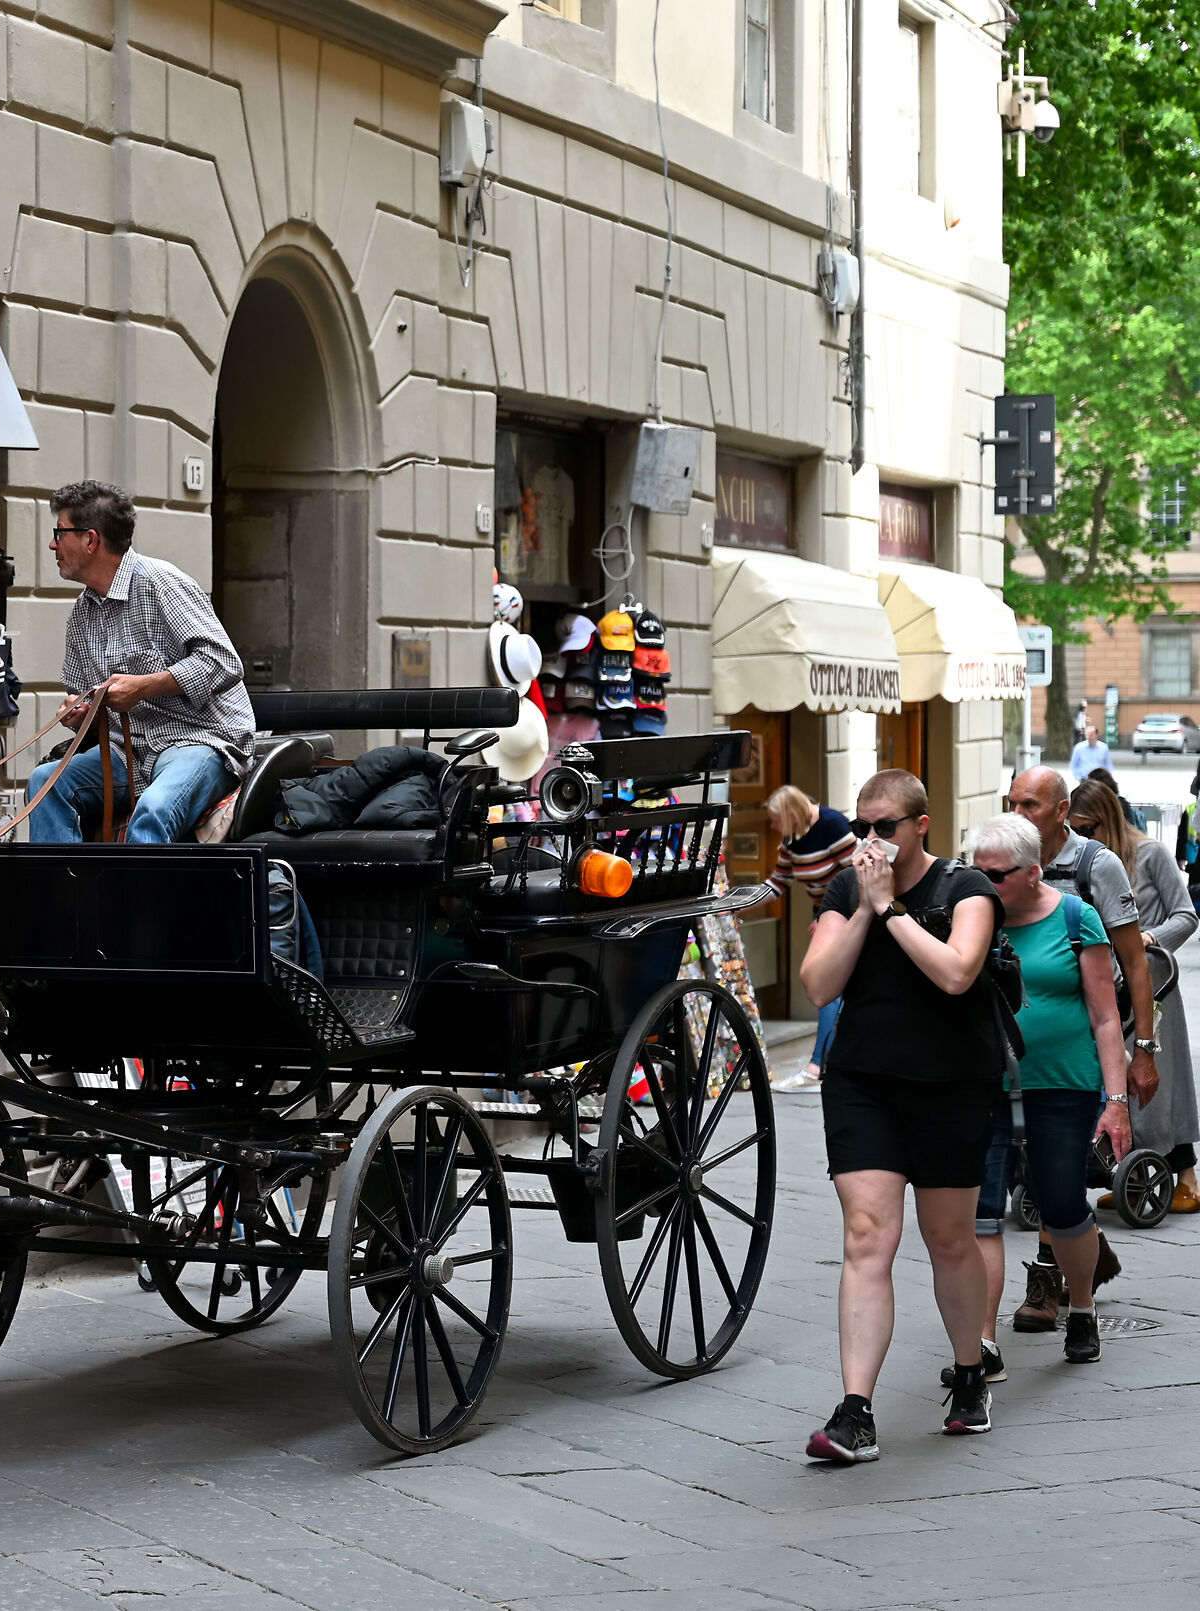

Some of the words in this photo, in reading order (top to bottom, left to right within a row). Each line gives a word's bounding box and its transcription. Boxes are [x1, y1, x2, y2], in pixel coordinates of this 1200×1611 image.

[809, 663, 853, 697] OTTICA
[856, 666, 901, 700] BIANCHI
[957, 661, 992, 689] OTTICA
[993, 662, 1010, 688] DAL
